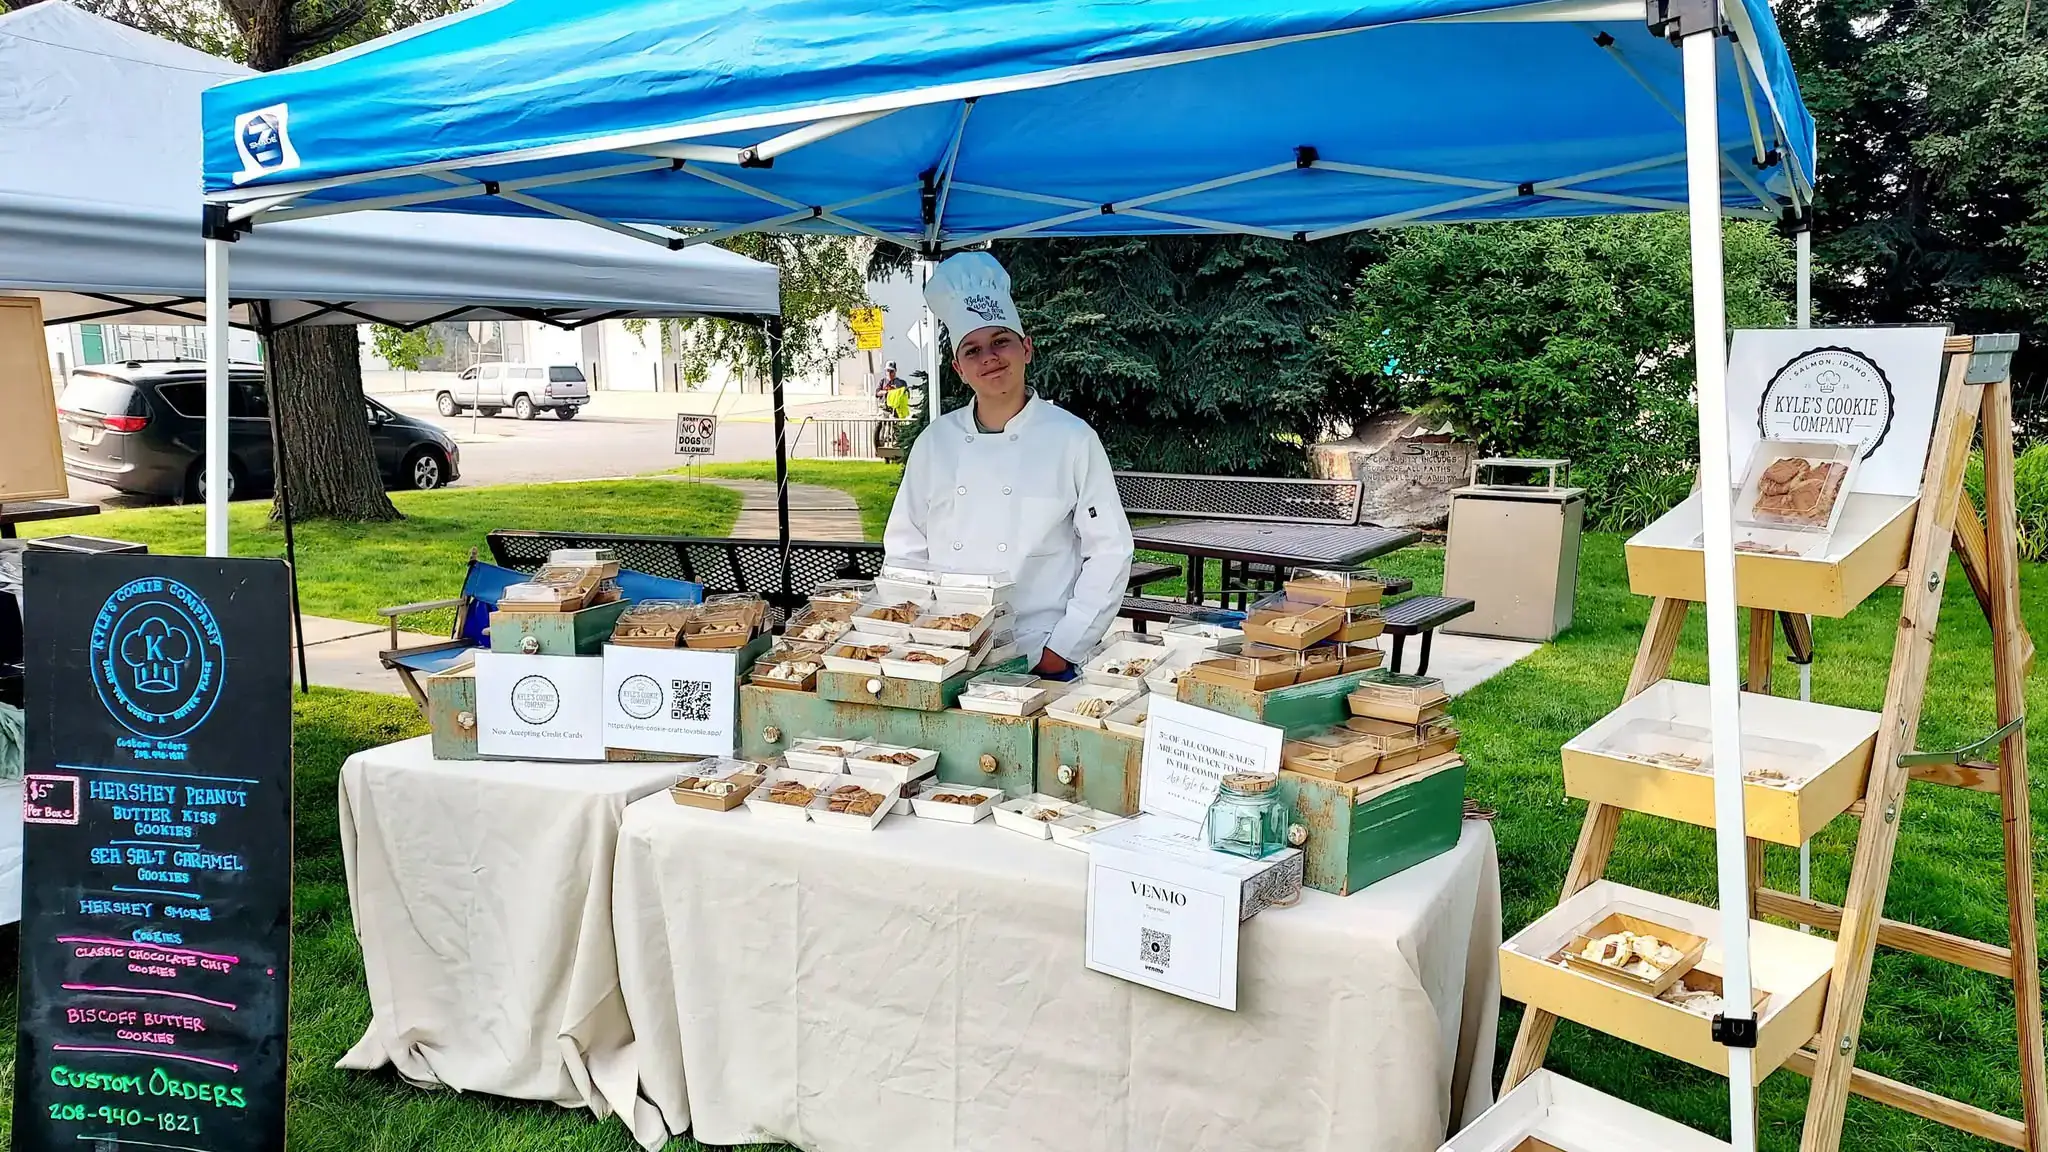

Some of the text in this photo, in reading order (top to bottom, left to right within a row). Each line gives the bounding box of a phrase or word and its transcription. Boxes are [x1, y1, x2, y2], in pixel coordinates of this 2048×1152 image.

[1839, 360, 1867, 378] IDAHO
[1775, 396, 1879, 416] KYLE'S COOKIE
[682, 423, 696, 434] NO
[1793, 415, 1854, 434] COMPANY
[679, 436, 701, 445] DOGS
[1402, 443, 1450, 456] Salmon
[1393, 465, 1403, 473] OF
[1407, 465, 1420, 473] ALL
[1423, 465, 1451, 473] FAITHS
[1427, 474, 1457, 482] ABILITY
[92, 580, 221, 650] KYLE'S COOKIE COMPANY
[145, 635, 164, 661] K
[492, 727, 583, 739] Now Accepting Credit Cards
[116, 737, 188, 752] Custom Orders
[1169, 734, 1181, 743] OF
[1181, 739, 1196, 748] ALL
[1197, 744, 1228, 758] COOKIE
[1229, 753, 1255, 767] SALES
[1157, 743, 1173, 753] ARE
[1173, 748, 1198, 761] GIVEN
[1198, 755, 1221, 769] BACK
[1222, 763, 1234, 773] TO
[1166, 757, 1175, 766] IN
[1176, 760, 1191, 772] THE
[89, 780, 247, 807] HERSHEY PEANUT
[28, 803, 62, 818] Per Box
[112, 805, 217, 825] BUTTER KISS
[134, 821, 193, 838] COOKIES
[90, 847, 244, 872] SEA SALT CARAMEL
[137, 867, 190, 884] COOKIES
[1131, 881, 1187, 907] VENMO
[79, 899, 212, 922] HERSHEY SMORE
[132, 929, 183, 945] COOKIES
[75, 946, 231, 974] CLASSIC CHOCOLATE CHIP
[128, 963, 177, 978] COOKIES
[1144, 964, 1164, 974] venmo
[66, 1007, 207, 1033] BISCOFF BUTTER
[116, 1028, 175, 1045] COOKIES
[48, 1103, 201, 1136] 208-940-1821
